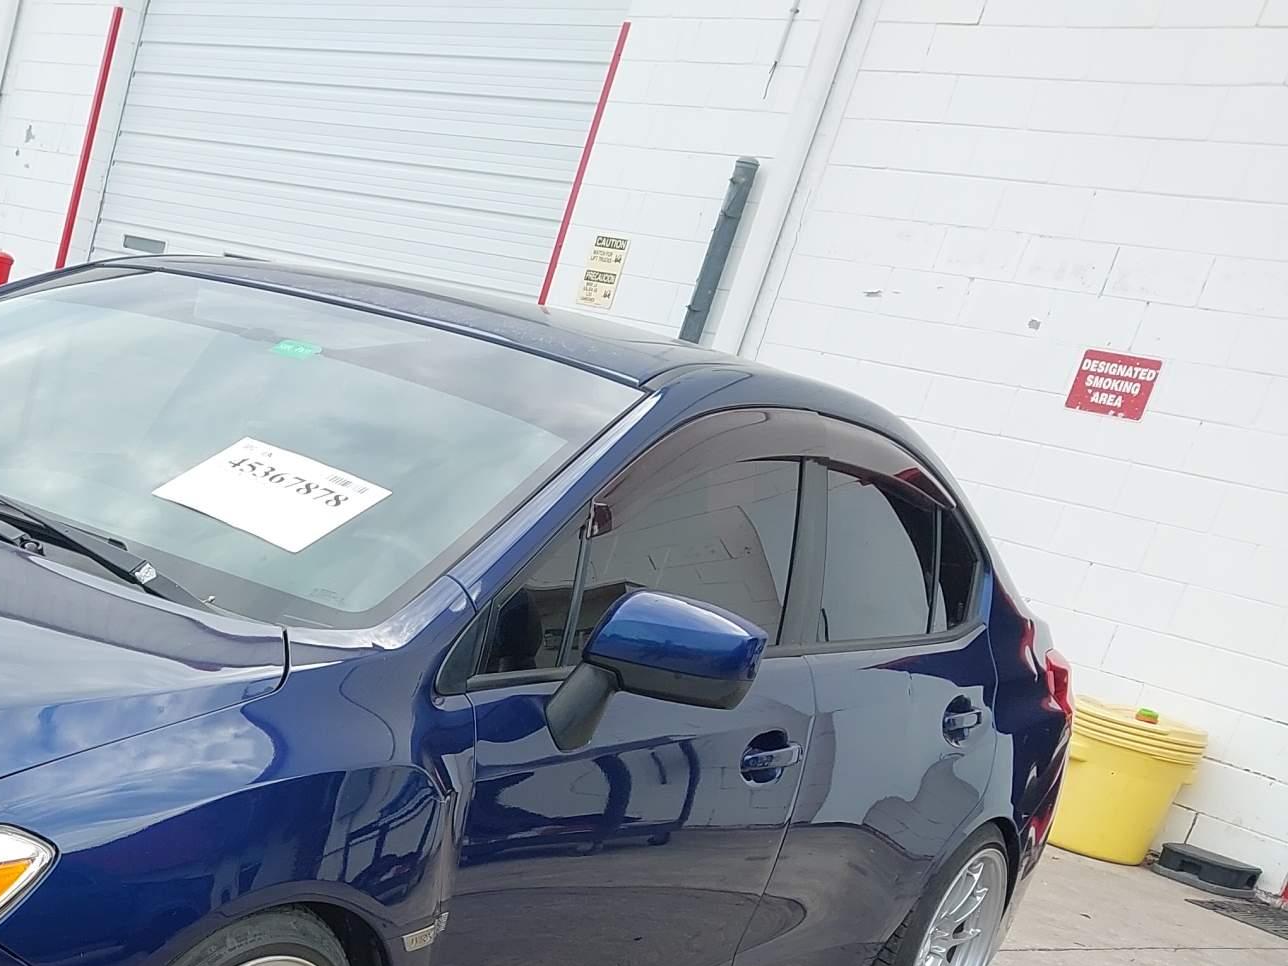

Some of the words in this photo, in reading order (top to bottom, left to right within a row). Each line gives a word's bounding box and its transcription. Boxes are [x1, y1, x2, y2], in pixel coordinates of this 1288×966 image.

[596, 236, 627, 250] CAUTION
[1081, 358, 1157, 382] DESIGNATED
[1084, 374, 1142, 396] SMOKING
[1090, 391, 1124, 408] AREA
[228, 457, 349, 508] 45367878
